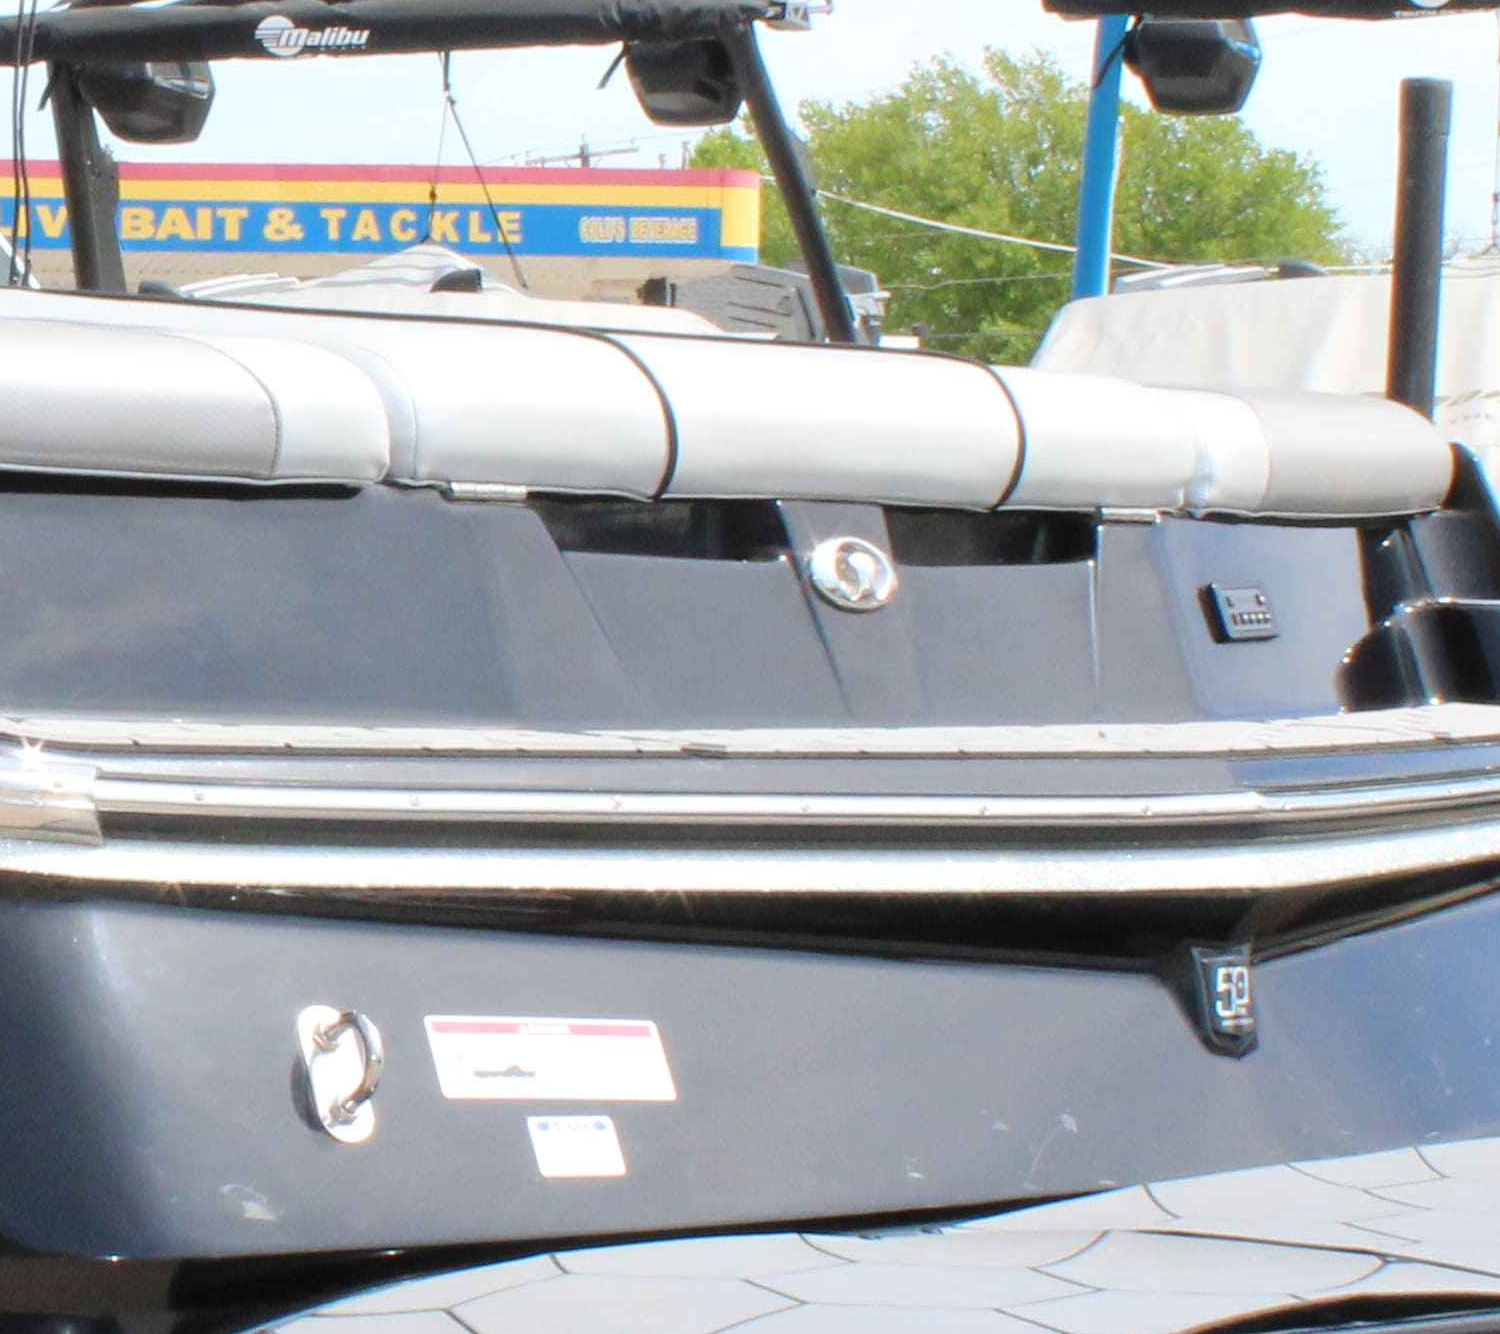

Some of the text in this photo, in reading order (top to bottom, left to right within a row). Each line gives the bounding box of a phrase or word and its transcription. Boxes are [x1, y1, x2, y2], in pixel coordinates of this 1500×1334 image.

[120, 207, 249, 241] BAIT
[263, 207, 305, 242] &
[320, 208, 523, 244] TACKLE
